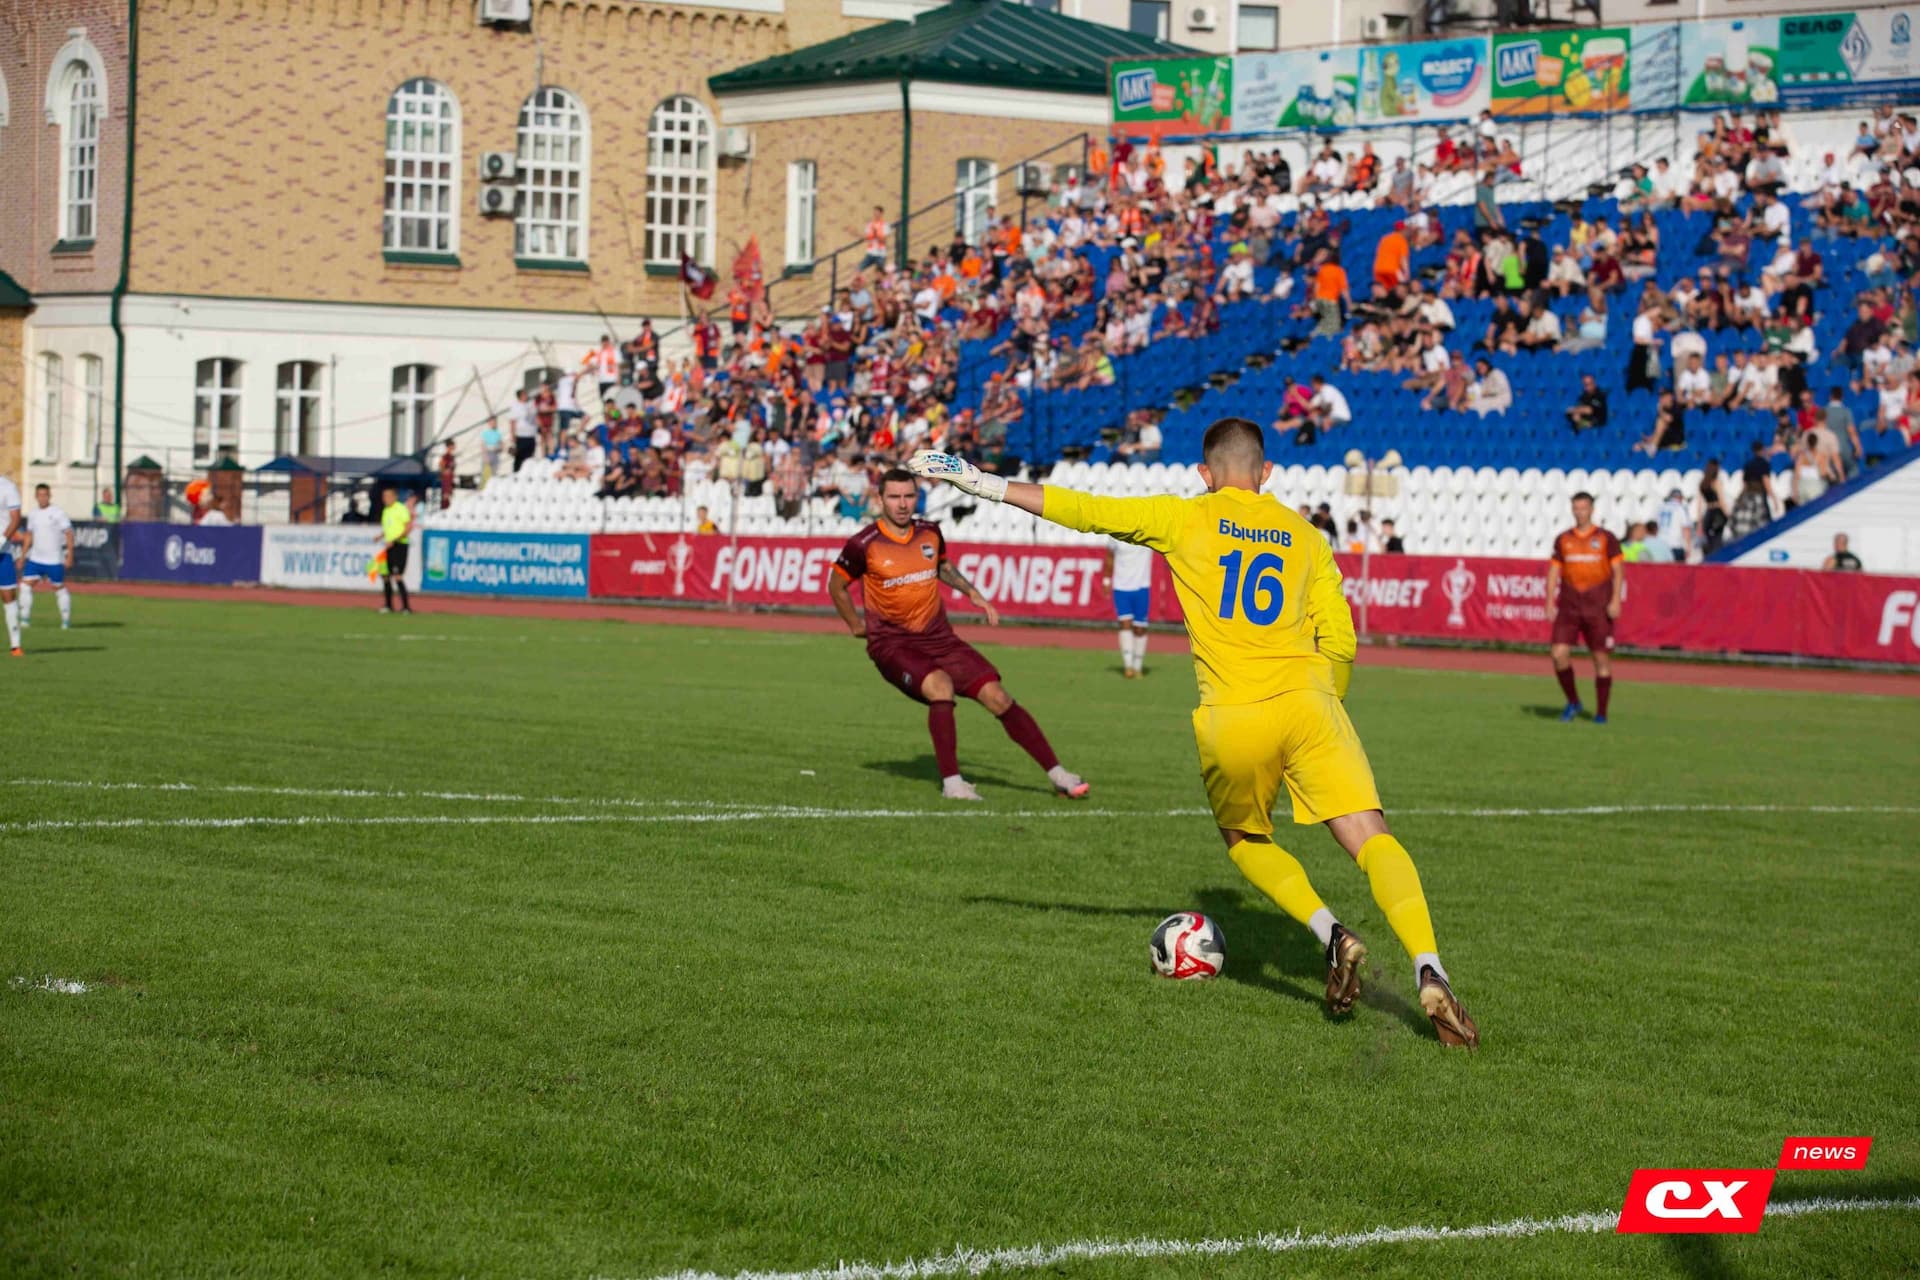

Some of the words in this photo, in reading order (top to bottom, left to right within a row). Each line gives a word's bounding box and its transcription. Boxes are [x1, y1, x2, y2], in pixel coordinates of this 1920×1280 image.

[184, 542, 216, 565] Russ
[454, 541, 582, 564] АДМИНИСТРАЦИЯ
[452, 562, 508, 586] ГОРОДА
[510, 565, 585, 586] БАРНАУЛА
[952, 553, 1103, 606] FONBET
[1219, 549, 1284, 626] 16
[1343, 577, 1428, 607] FONBET
[1877, 590, 1920, 646] F
